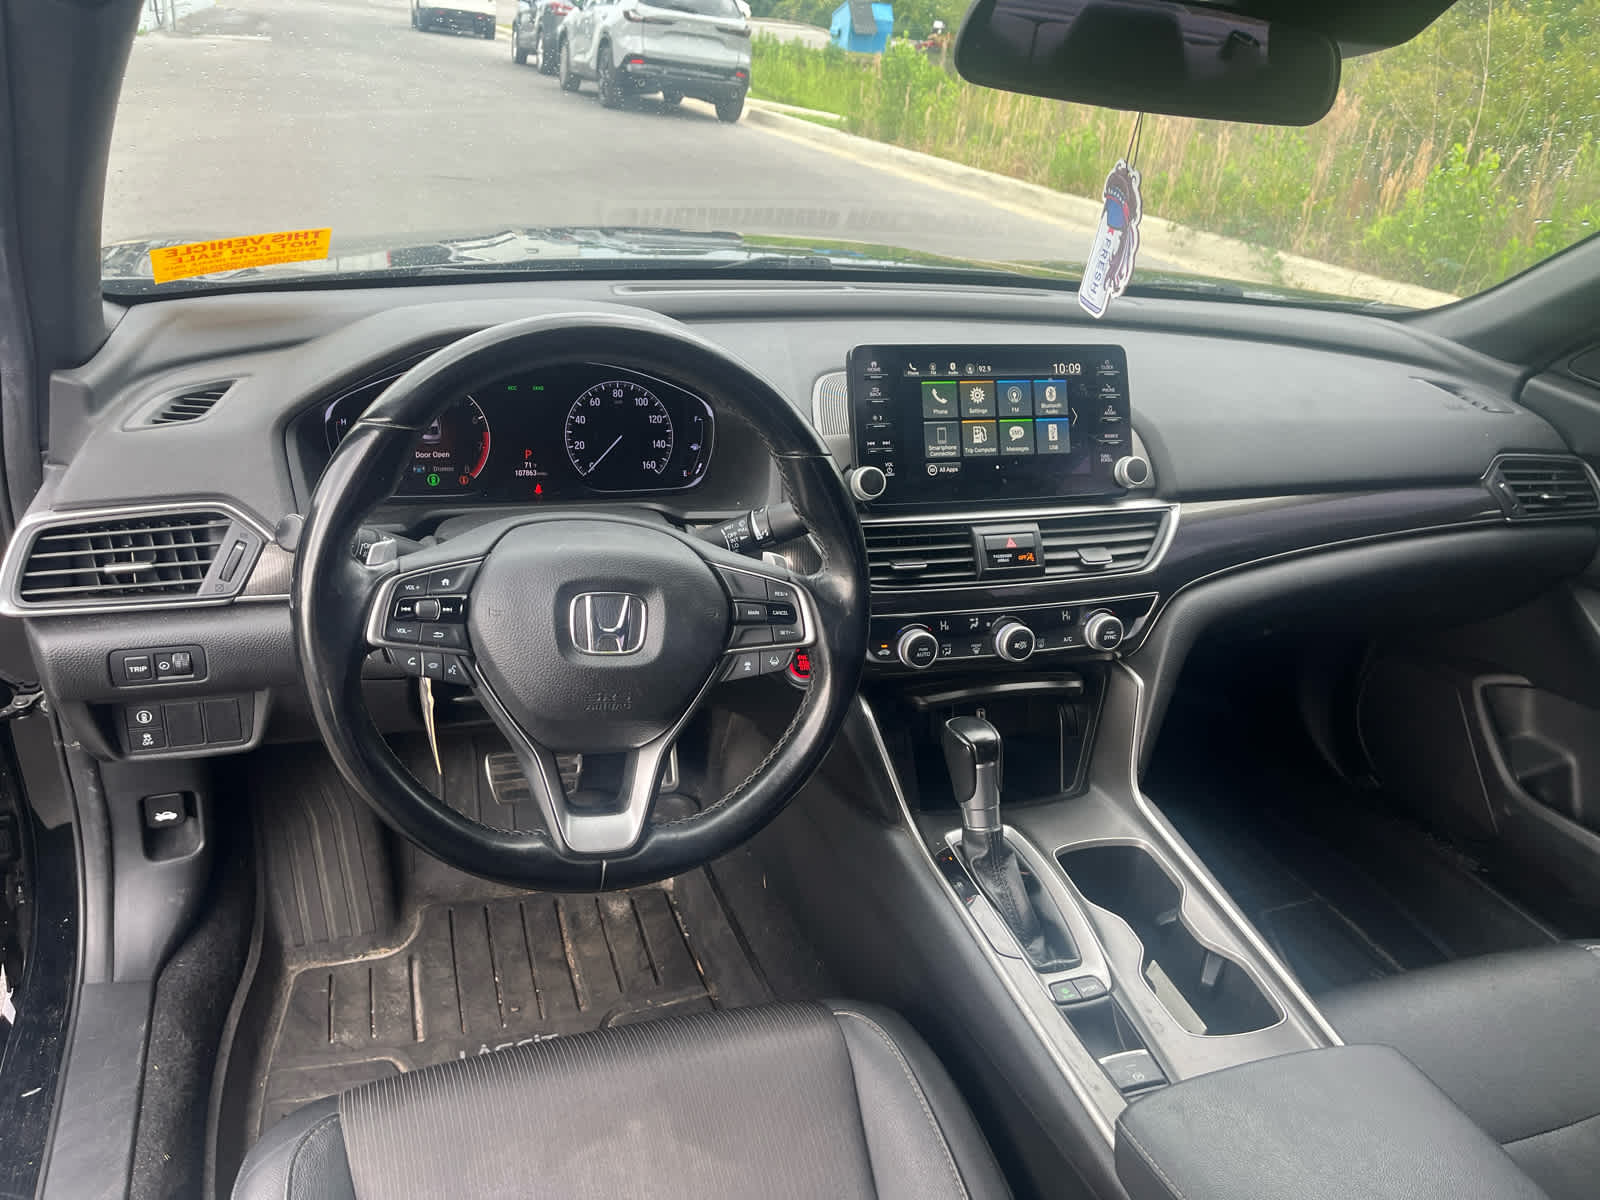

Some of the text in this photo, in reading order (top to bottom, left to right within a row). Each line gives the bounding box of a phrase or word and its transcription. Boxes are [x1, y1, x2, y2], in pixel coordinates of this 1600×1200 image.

[1087, 238, 1112, 295] FRESH
[1053, 362, 1081, 374] 10:09
[612, 389, 623, 398] 80
[589, 398, 600, 407] 60
[635, 397, 649, 407] 100
[575, 415, 586, 424] 40
[648, 415, 662, 424] 120
[574, 440, 585, 450] 20
[652, 440, 666, 449] 140
[432, 451, 450, 459] Open
[524, 449, 532, 459] P
[643, 460, 656, 470] 160
[515, 469, 537, 477] 107863
